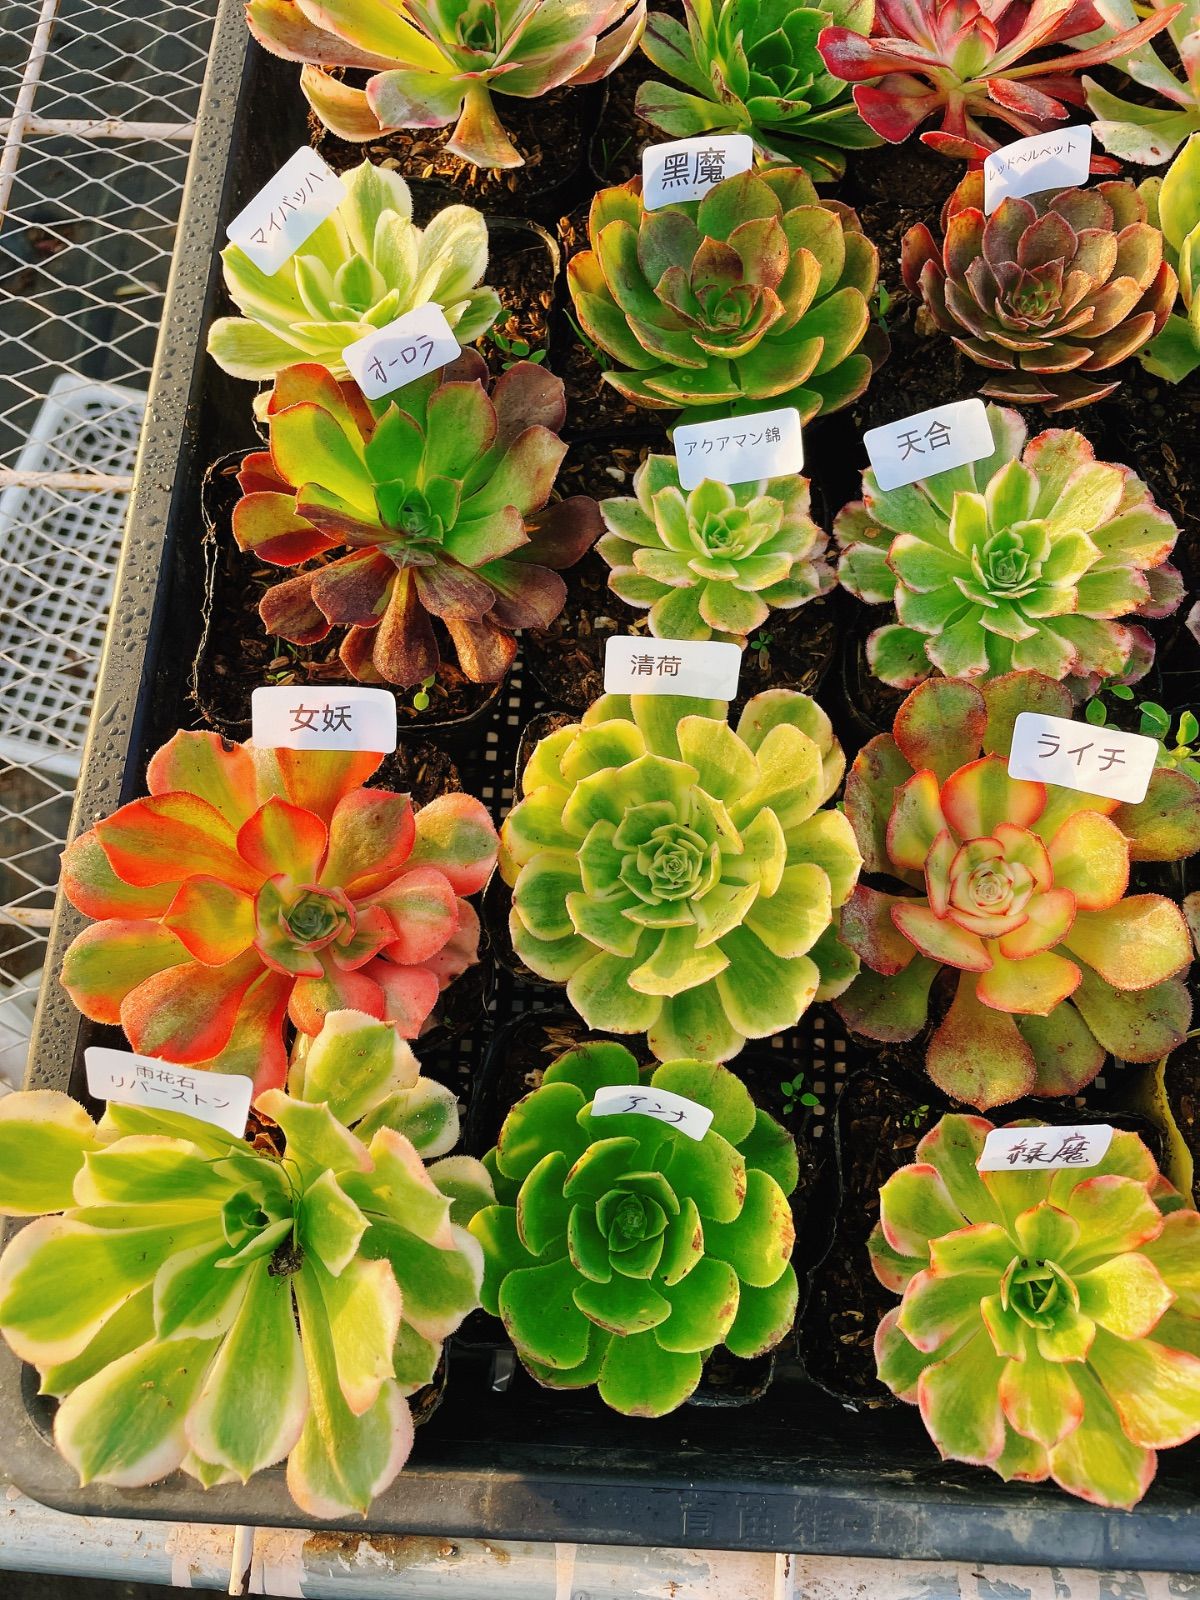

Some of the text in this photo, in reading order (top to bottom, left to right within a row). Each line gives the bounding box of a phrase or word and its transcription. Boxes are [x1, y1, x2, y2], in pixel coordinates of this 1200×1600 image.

[989, 141, 1076, 181] レッドベルベット
[250, 172, 324, 244] マイバッハ
[367, 334, 434, 384] オーロラ
[684, 426, 781, 456] アクアマン錦
[896, 420, 951, 461] 天合
[630, 654, 682, 676] 清荷
[289, 703, 353, 733] 女妖
[1037, 733, 1126, 771] ライチ
[111, 1074, 230, 1109] リバーストン
[135, 1064, 196, 1090] 雨花石
